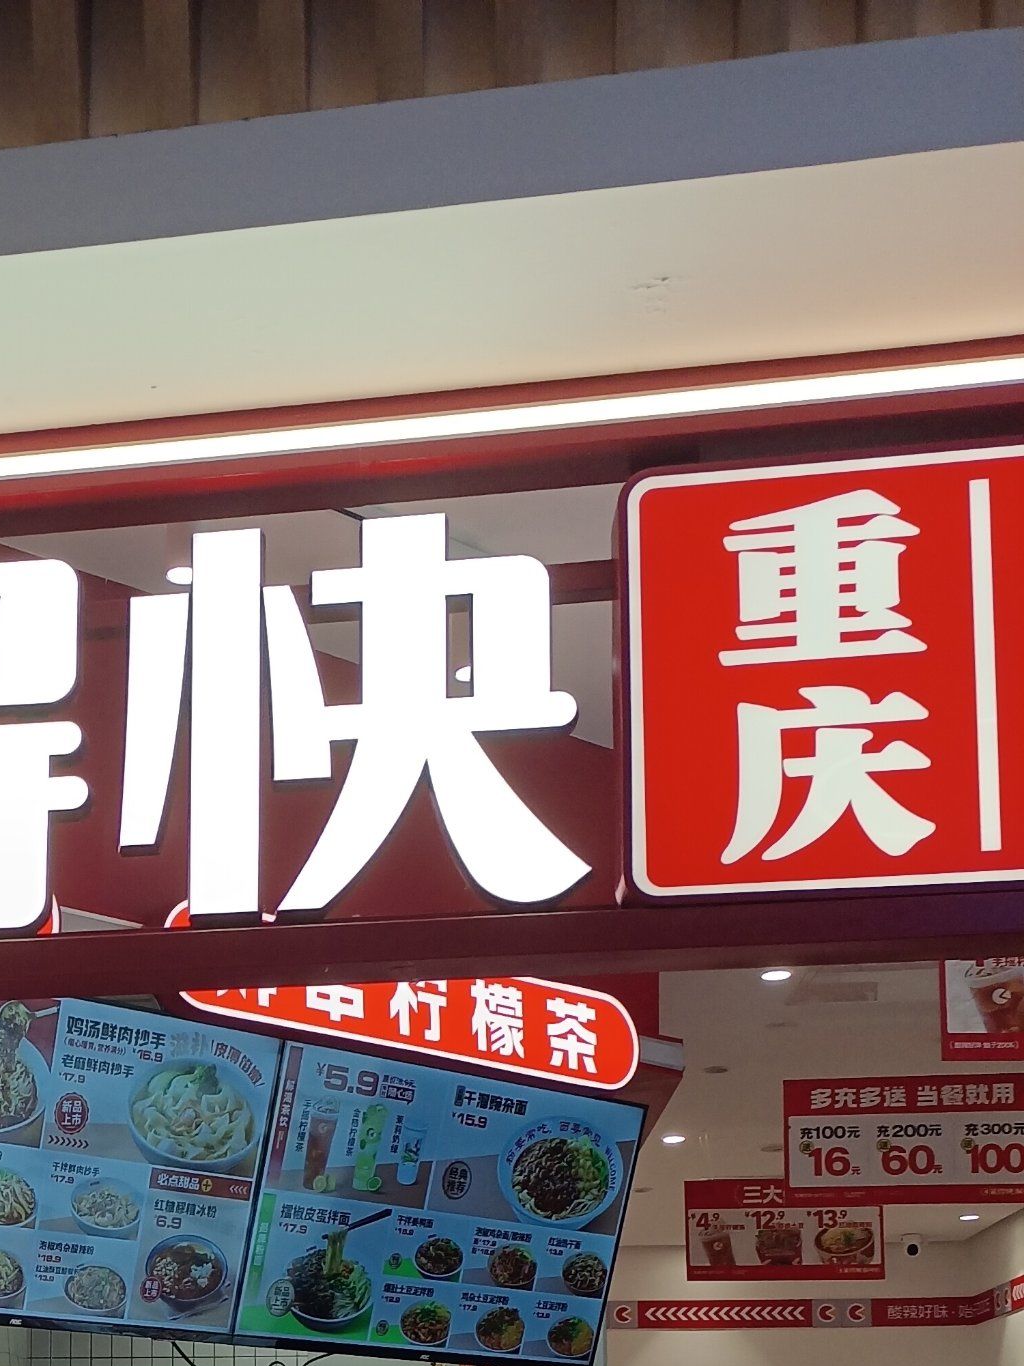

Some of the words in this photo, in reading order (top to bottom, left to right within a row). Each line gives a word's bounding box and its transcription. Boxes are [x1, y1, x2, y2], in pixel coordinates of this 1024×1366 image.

[718, 489, 937, 866] 重庆
[66, 1016, 166, 1049] 鸡汤鲜肉抄手
[317, 1062, 380, 1097] ¥5.9
[61, 1100, 83, 1113] 新品
[810, 1086, 907, 1109] 多充多送
[917, 1083, 1015, 1107] 当餐就用
[61, 1112, 83, 1126] 上市
[800, 1125, 861, 1141] 充100元
[877, 1124, 942, 1139] 充200元
